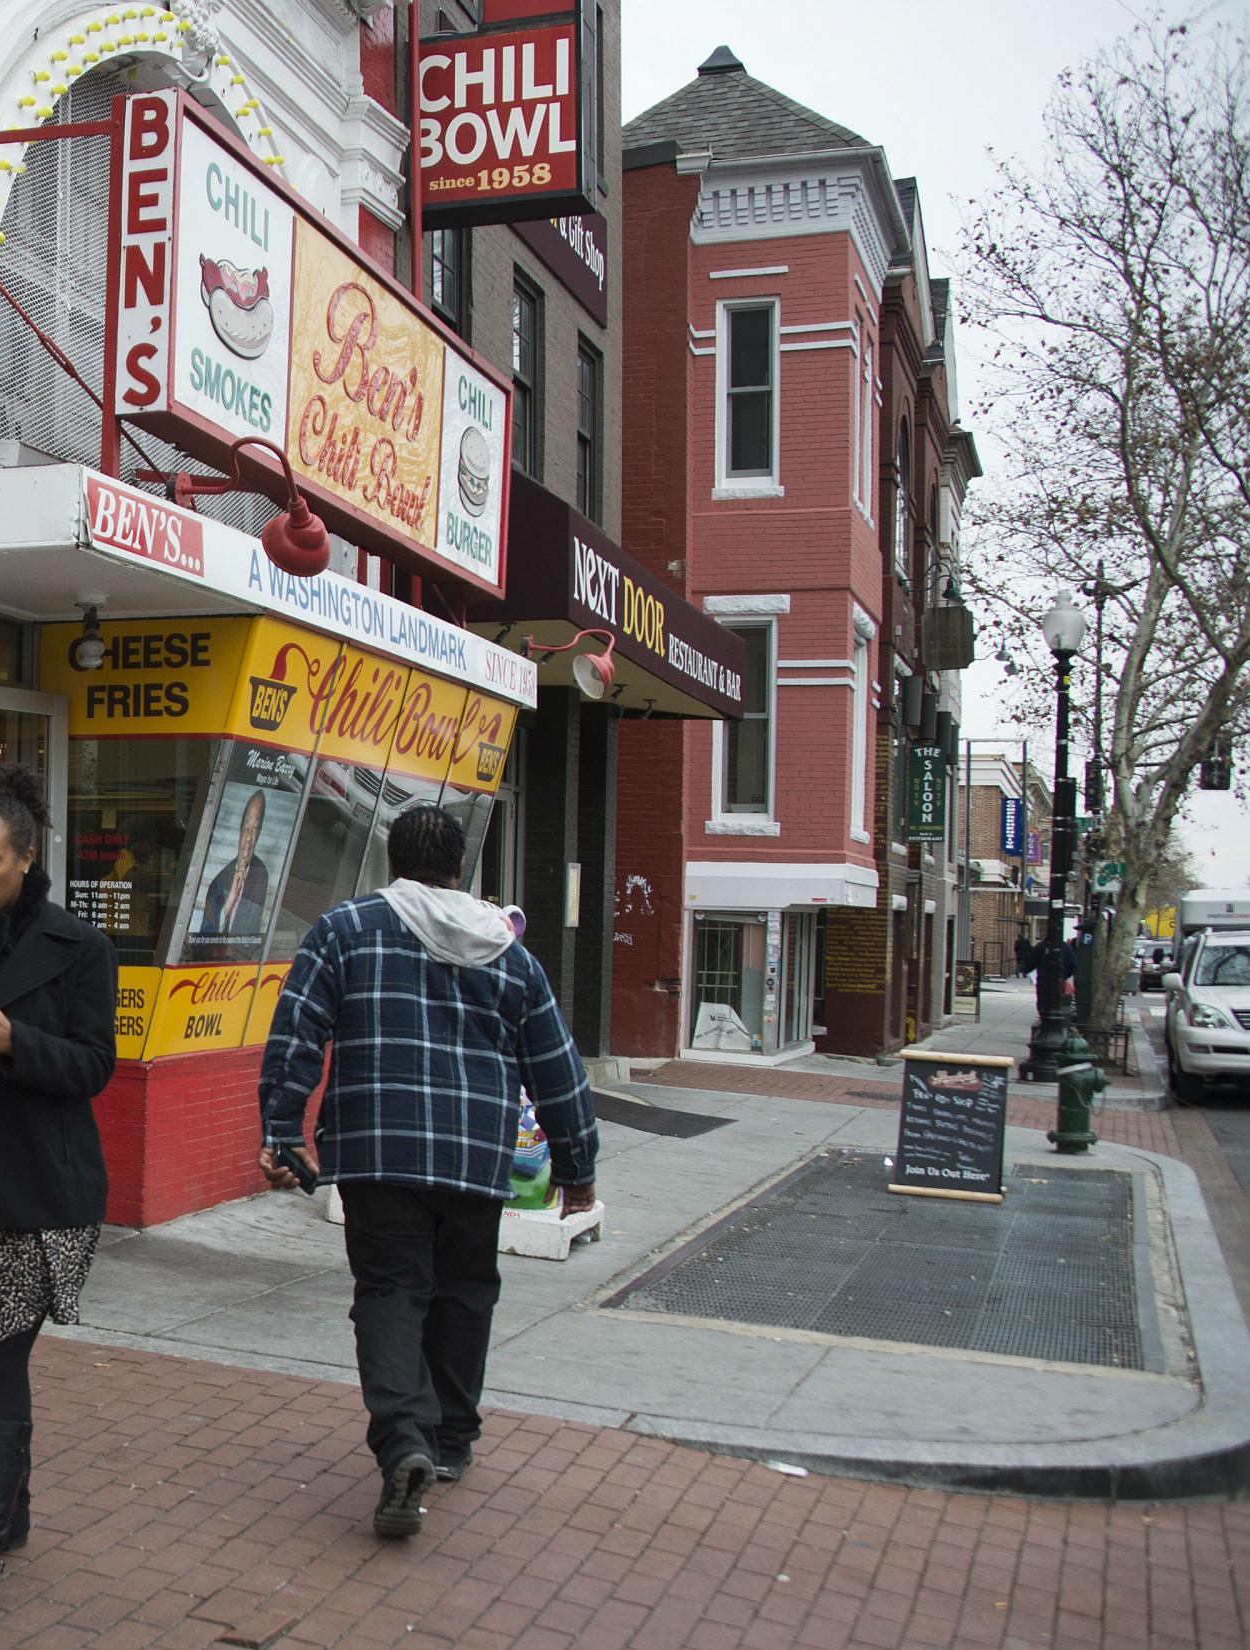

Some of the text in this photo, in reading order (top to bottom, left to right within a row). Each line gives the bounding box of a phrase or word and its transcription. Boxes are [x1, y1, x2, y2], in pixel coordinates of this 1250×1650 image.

[419, 38, 569, 112] CHILI
[420, 102, 576, 168] BOWL
[429, 162, 552, 191] since 1958
[206, 162, 270, 252] CHILI
[122, 96, 170, 407] BEN'S
[568, 216, 584, 259] Gift
[585, 230, 604, 292] Shop
[190, 347, 272, 433] SMOKES
[313, 281, 424, 442] Ben's
[458, 374, 494, 432] CHILI
[299, 394, 432, 531] Chili Bowl
[446, 511, 492, 568] BURGER
[68, 632, 211, 672] CHEESE
[248, 548, 536, 700] A WASHINGTON LANDMARK SINCE 1958
[623, 575, 666, 658] DOOR
[668, 632, 719, 691] RESTAURANT
[718, 665, 725, 694] &
[726, 668, 742, 702] BAR
[86, 682, 190, 719] FRIES
[252, 685, 288, 725] BEN'S
[309, 654, 481, 765] Chili Bowl
[246, 749, 274, 770] Marion
[914, 747, 942, 758] THE
[922, 760, 934, 823] SALOON
[70, 880, 90, 888] HOURS
[90, 880, 98, 888] OF
[70, 900, 88, 908] M-Th:
[74, 890, 89, 898] Sun:
[113, 892, 130, 900] 11pm
[78, 910, 88, 918] Fri:
[179, 970, 247, 1005] Chili
[184, 1014, 222, 1040] BOWL
[905, 1164, 925, 1176] Join
[927, 1166, 940, 1176] Us
[941, 1168, 960, 1178] Out
